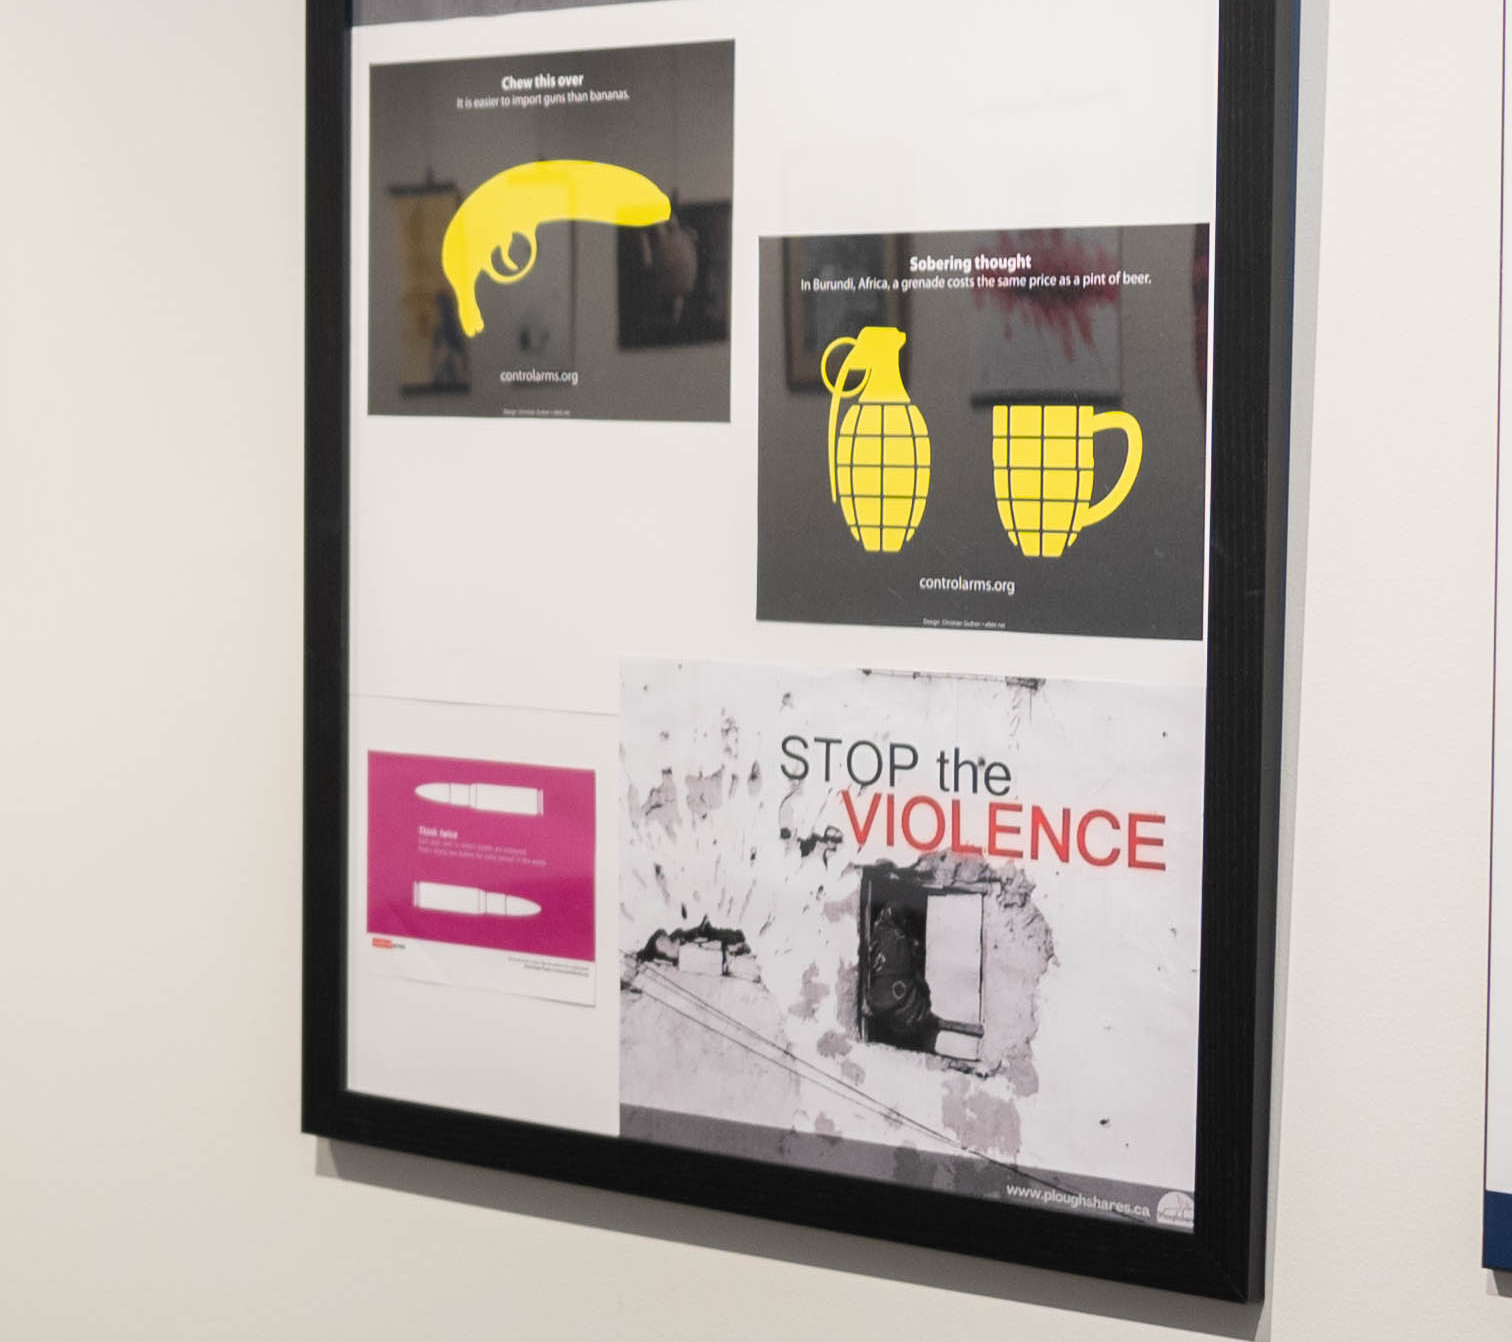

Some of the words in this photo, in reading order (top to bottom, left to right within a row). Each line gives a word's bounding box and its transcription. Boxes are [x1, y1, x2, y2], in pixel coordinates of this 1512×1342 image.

[501, 76, 533, 91] Chew
[535, 74, 556, 88] this
[558, 75, 583, 87] over
[910, 256, 972, 273] Sobering
[975, 253, 1032, 271] thought
[801, 280, 810, 290] In
[814, 278, 855, 292] Burundi,
[858, 278, 890, 291] Africa,
[893, 281, 899, 289] a
[901, 278, 945, 292] grenade
[947, 278, 975, 288] costs
[977, 275, 995, 287] the
[997, 278, 1026, 287] same
[1029, 275, 1056, 289] price
[1059, 277, 1071, 286] as
[1074, 277, 1080, 285] a
[1083, 273, 1106, 287] pint
[1108, 271, 1121, 284] of
[1122, 271, 1151, 285] beer.
[500, 369, 578, 387] controlarms.org
[920, 576, 1015, 595] controlarms.org
[780, 735, 920, 788] STOP
[937, 748, 1011, 796] the
[840, 789, 1167, 871] VIOLENCE
